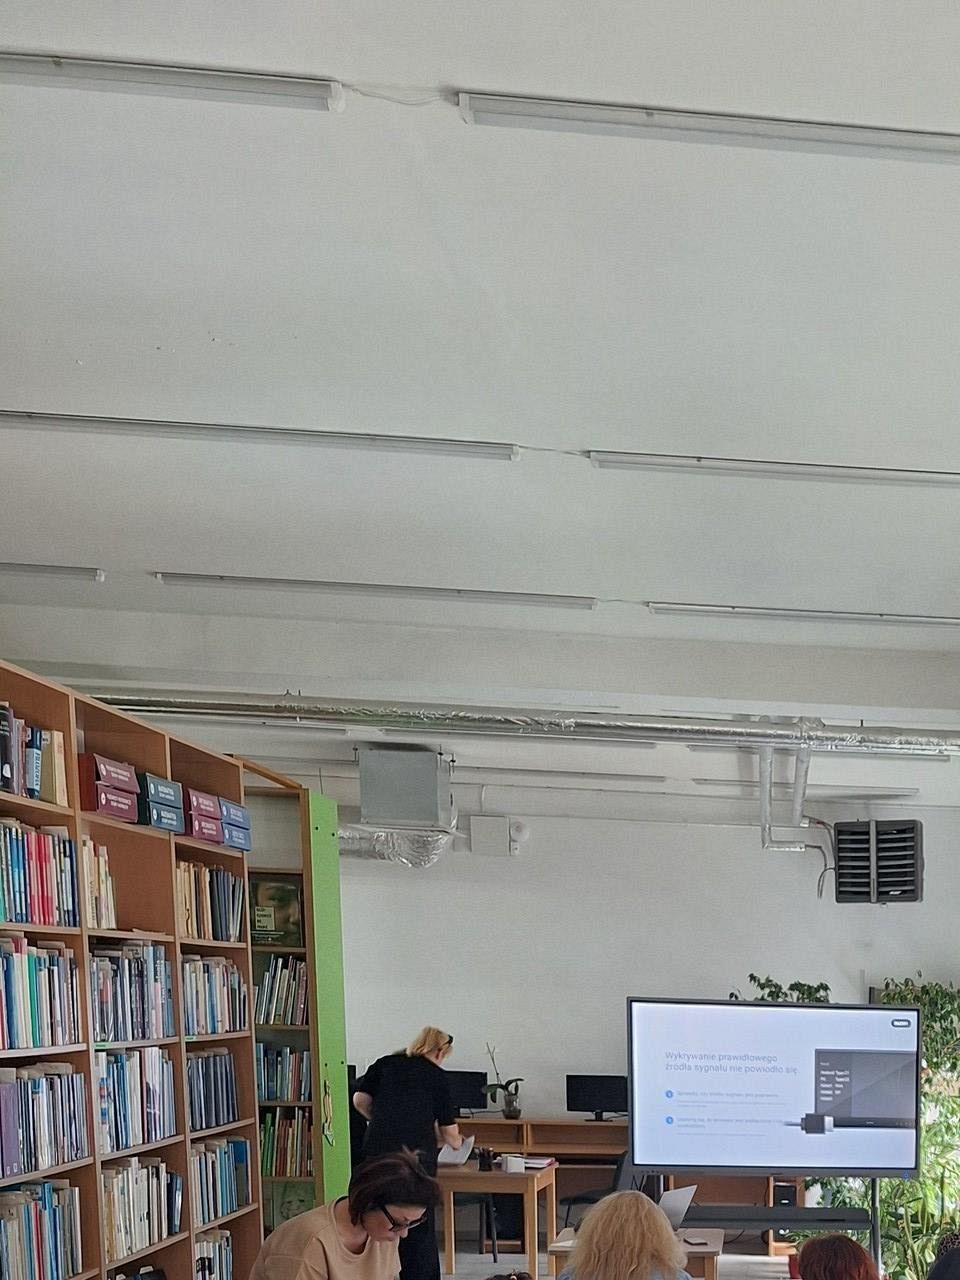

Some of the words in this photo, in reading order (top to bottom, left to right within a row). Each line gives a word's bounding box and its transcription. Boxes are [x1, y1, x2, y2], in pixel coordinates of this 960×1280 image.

[665, 1051, 716, 1062] Wykrywanie
[718, 1053, 778, 1064] prawidłowego
[695, 1063, 728, 1073] sygnału
[729, 1065, 743, 1073] nie
[744, 1064, 784, 1075] powiodło
